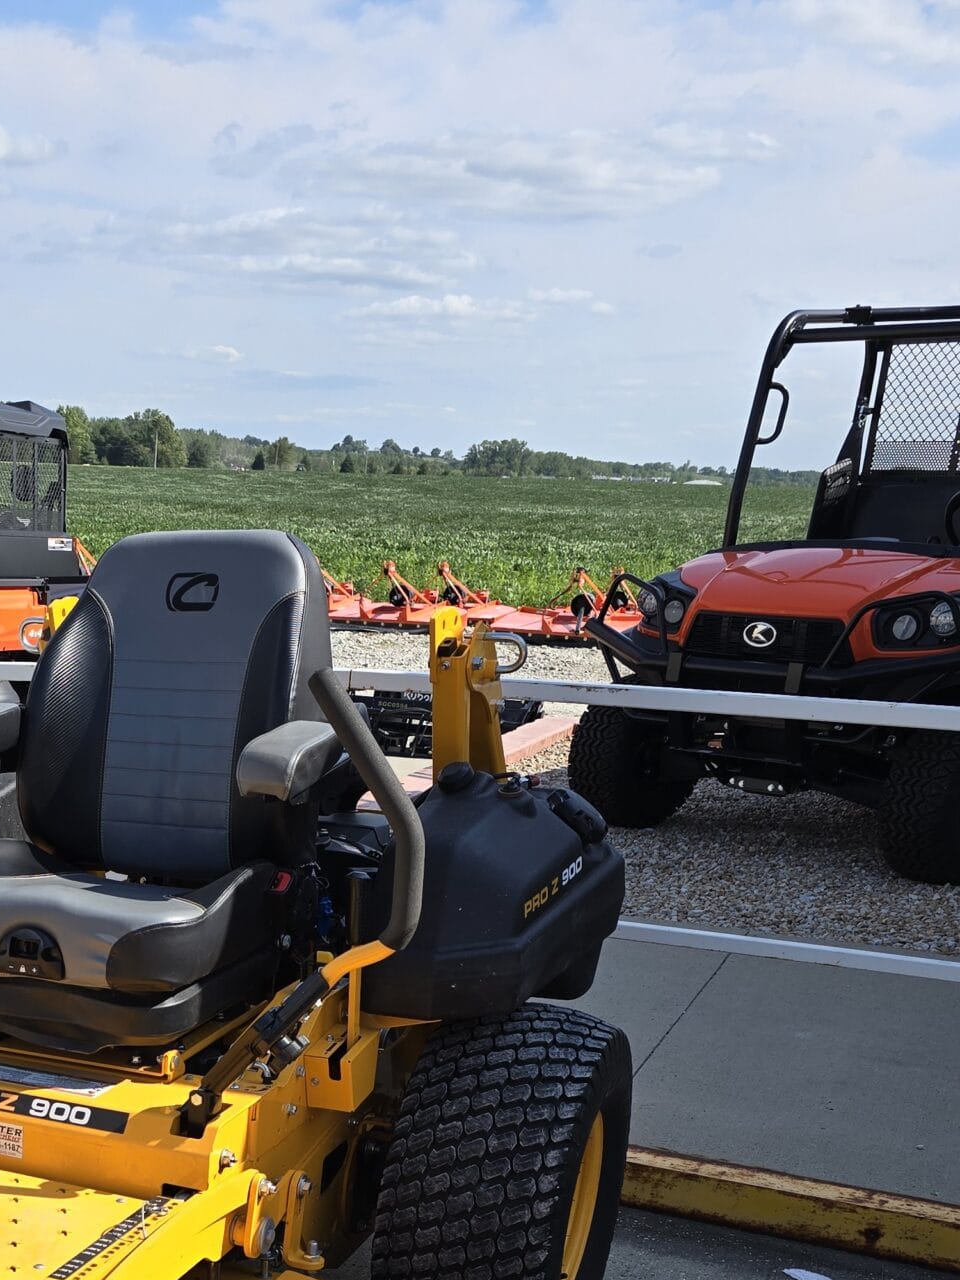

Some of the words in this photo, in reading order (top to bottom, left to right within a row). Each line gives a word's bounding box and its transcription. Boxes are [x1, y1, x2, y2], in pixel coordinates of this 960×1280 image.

[524, 886, 549, 919] PRO
[551, 876, 559, 896] Z
[562, 856, 583, 887] 900
[29, 1098, 92, 1126] 900
